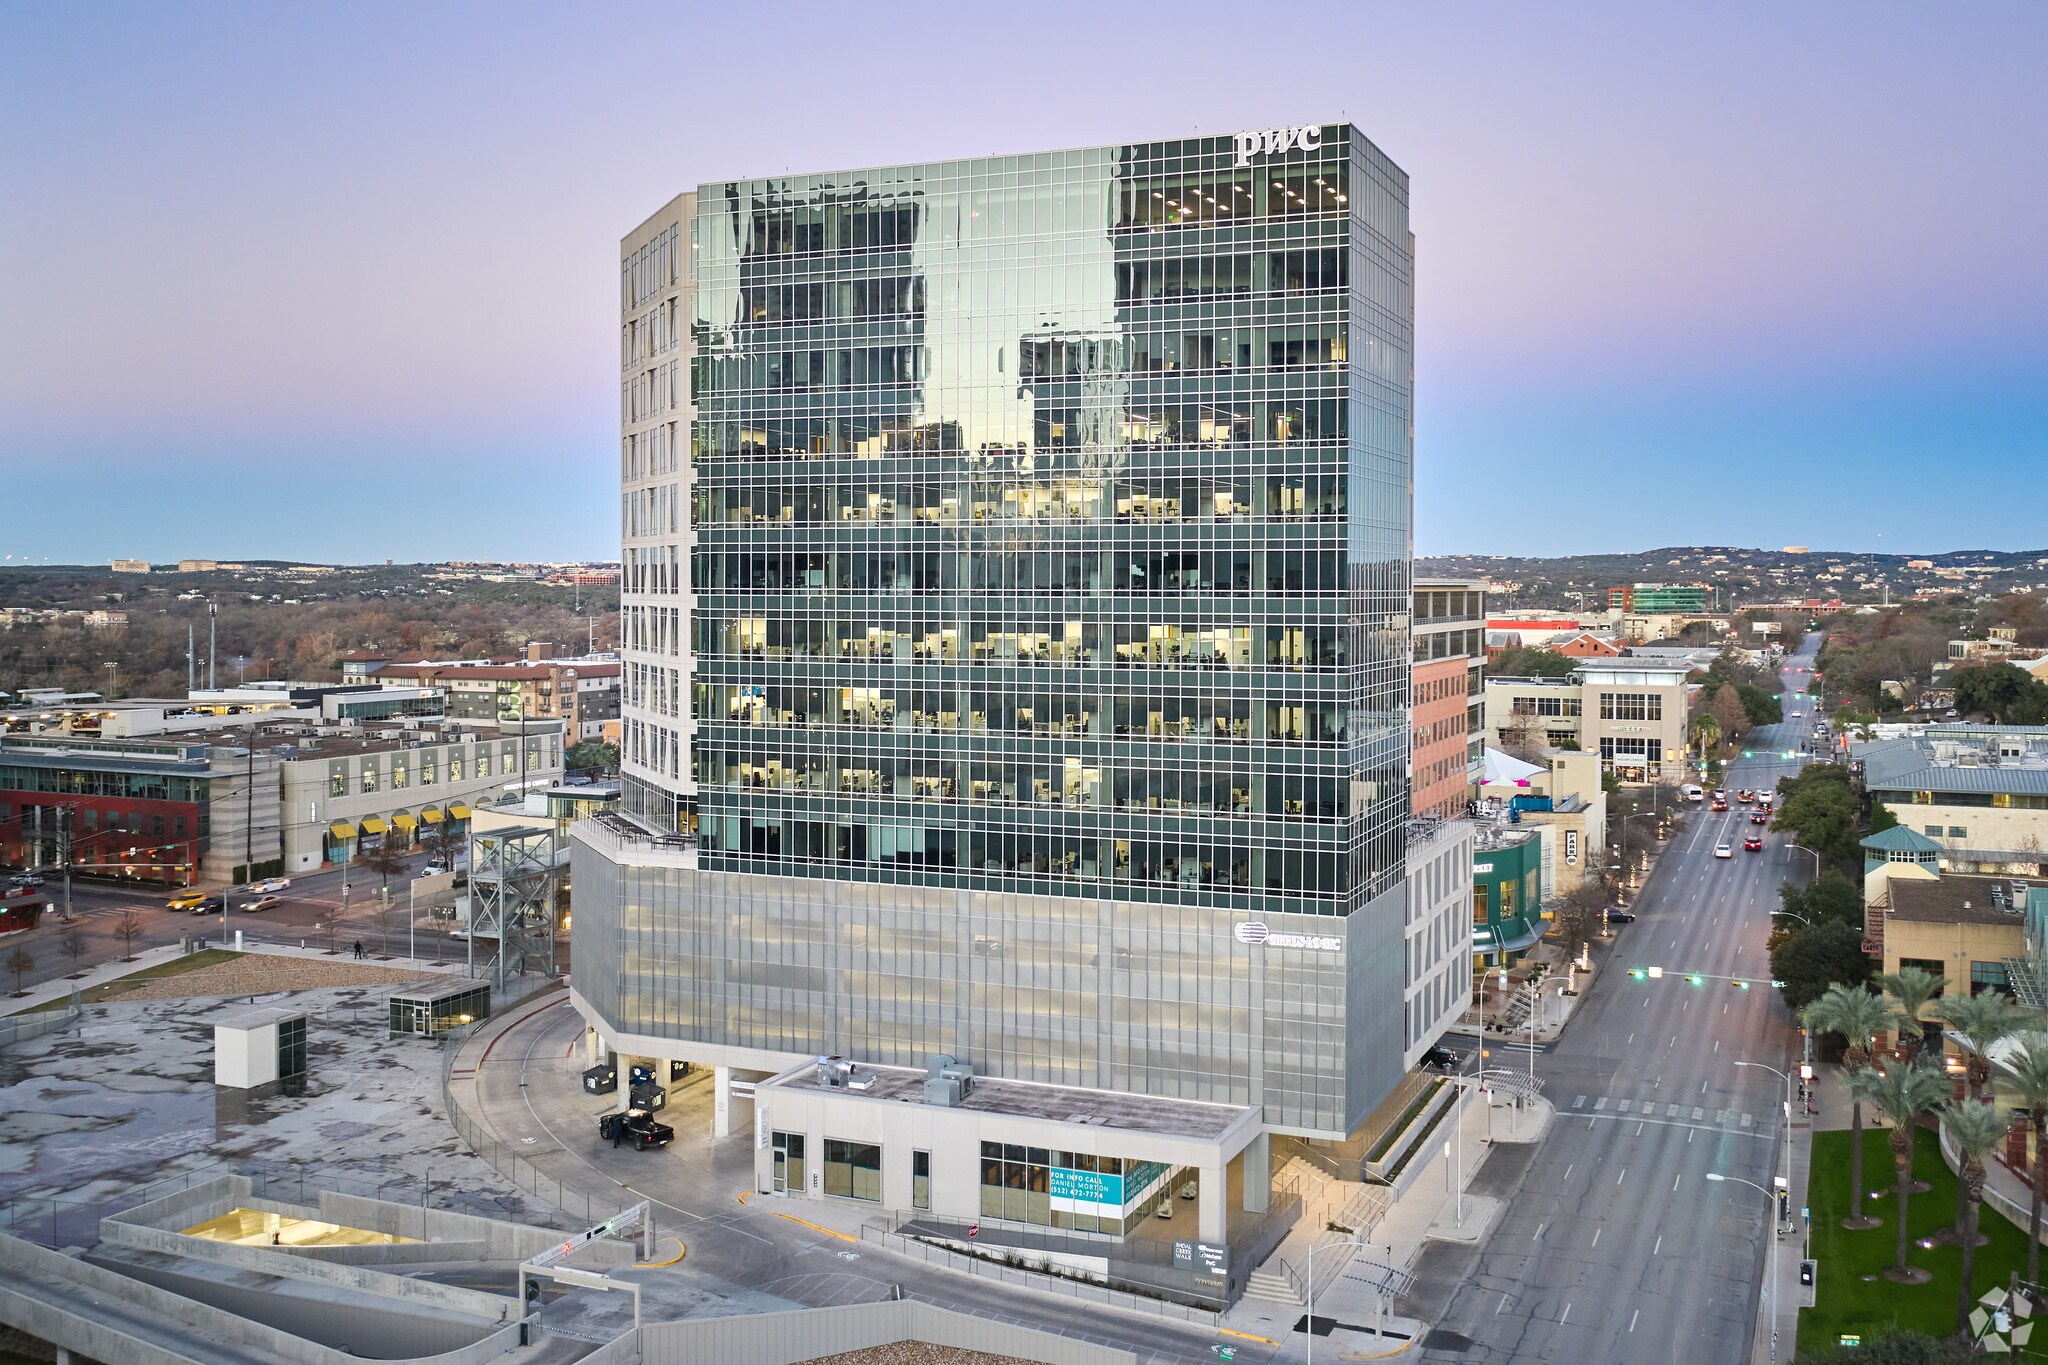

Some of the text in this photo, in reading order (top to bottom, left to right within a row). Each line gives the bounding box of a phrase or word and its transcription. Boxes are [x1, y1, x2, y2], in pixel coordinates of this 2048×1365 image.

[1234, 125, 1321, 167] pwc
[1568, 834, 1576, 854] PARK
[1266, 933, 1341, 951] CIRRUS LOGIC
[1051, 1171, 1103, 1184] FOR INFO CALL
[1051, 1179, 1109, 1192] DANIEL MORTON
[1051, 1186, 1068, 1195] (512)
